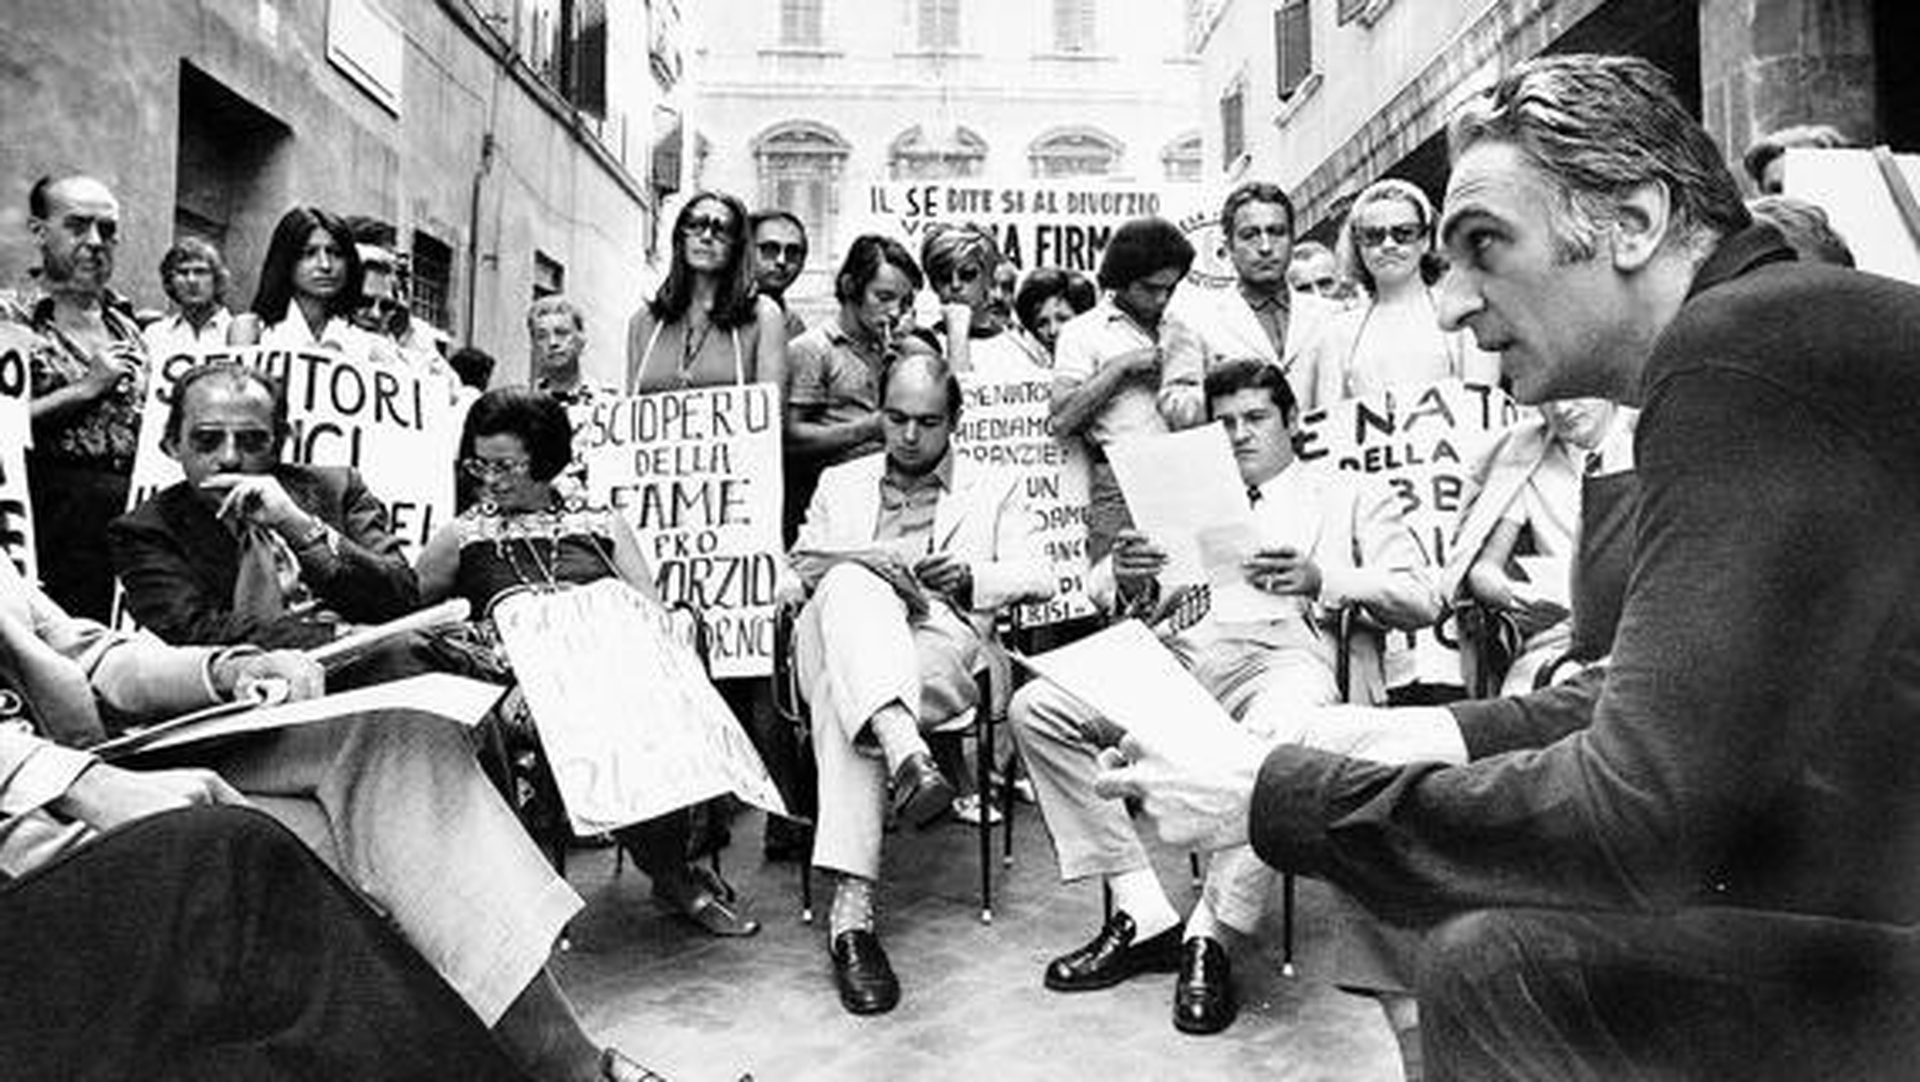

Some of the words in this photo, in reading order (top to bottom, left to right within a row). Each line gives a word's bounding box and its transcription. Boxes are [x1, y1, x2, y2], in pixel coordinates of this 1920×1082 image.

[905, 185, 939, 218] SE
[1035, 223, 1112, 272] FIRM
[634, 443, 732, 477] DELLA
[609, 478, 751, 530] FAME
[654, 531, 719, 559] PRO
[655, 552, 777, 610] ORZIO
